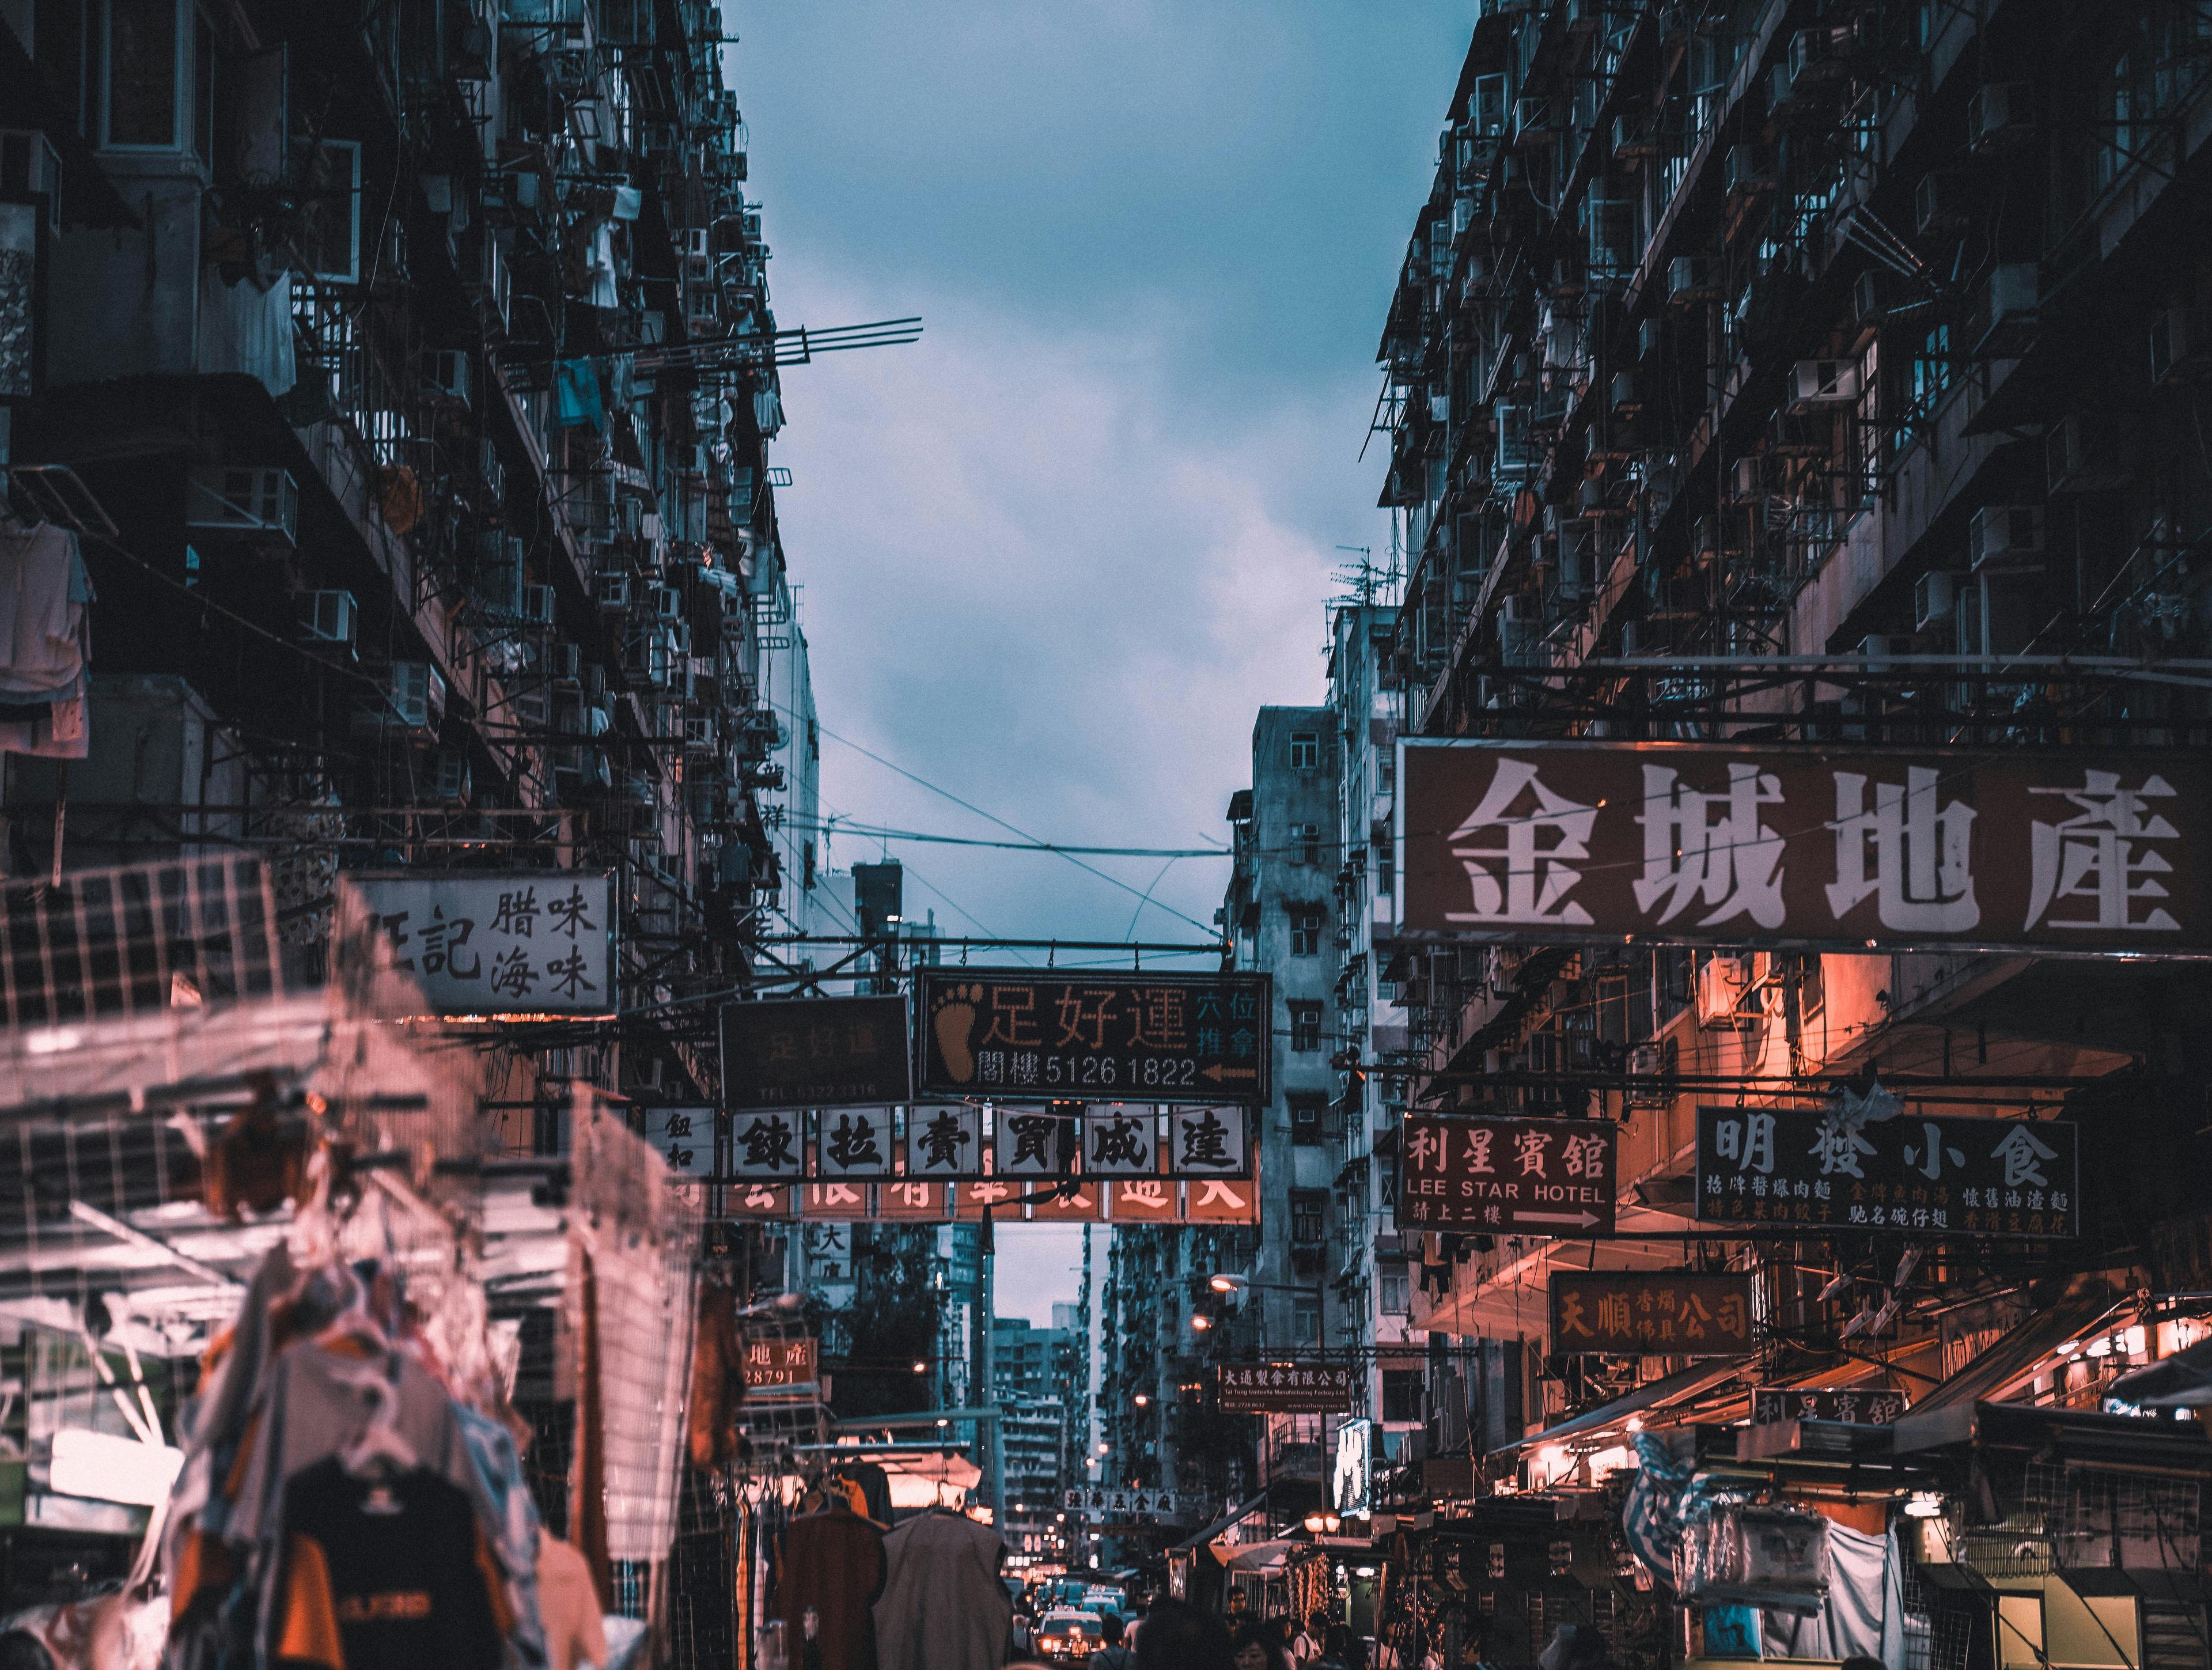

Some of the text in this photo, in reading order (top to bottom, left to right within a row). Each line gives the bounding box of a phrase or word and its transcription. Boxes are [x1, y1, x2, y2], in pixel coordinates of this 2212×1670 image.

[1446, 756, 2181, 932] 金城地產
[491, 944, 597, 1000] 海味
[982, 984, 1188, 1048] 足好運
[1046, 1056, 1116, 1084] 5126
[1128, 1058, 1196, 1085] 1822
[1716, 1112, 2059, 1187] 明發小食
[1407, 1178, 1605, 1203] LEE STAR HOTEL
[1412, 1201, 1502, 1225] 請上二樓
[1849, 1205, 1949, 1228] 馳名碗仔翅
[1560, 1292, 1633, 1338] 天順
[1678, 1292, 1747, 1340] 公司
[749, 1343, 807, 1366] 地產
[1225, 1369, 1346, 1387] 大通製傘有限公司
[1314, 1389, 1335, 1397] Factory
